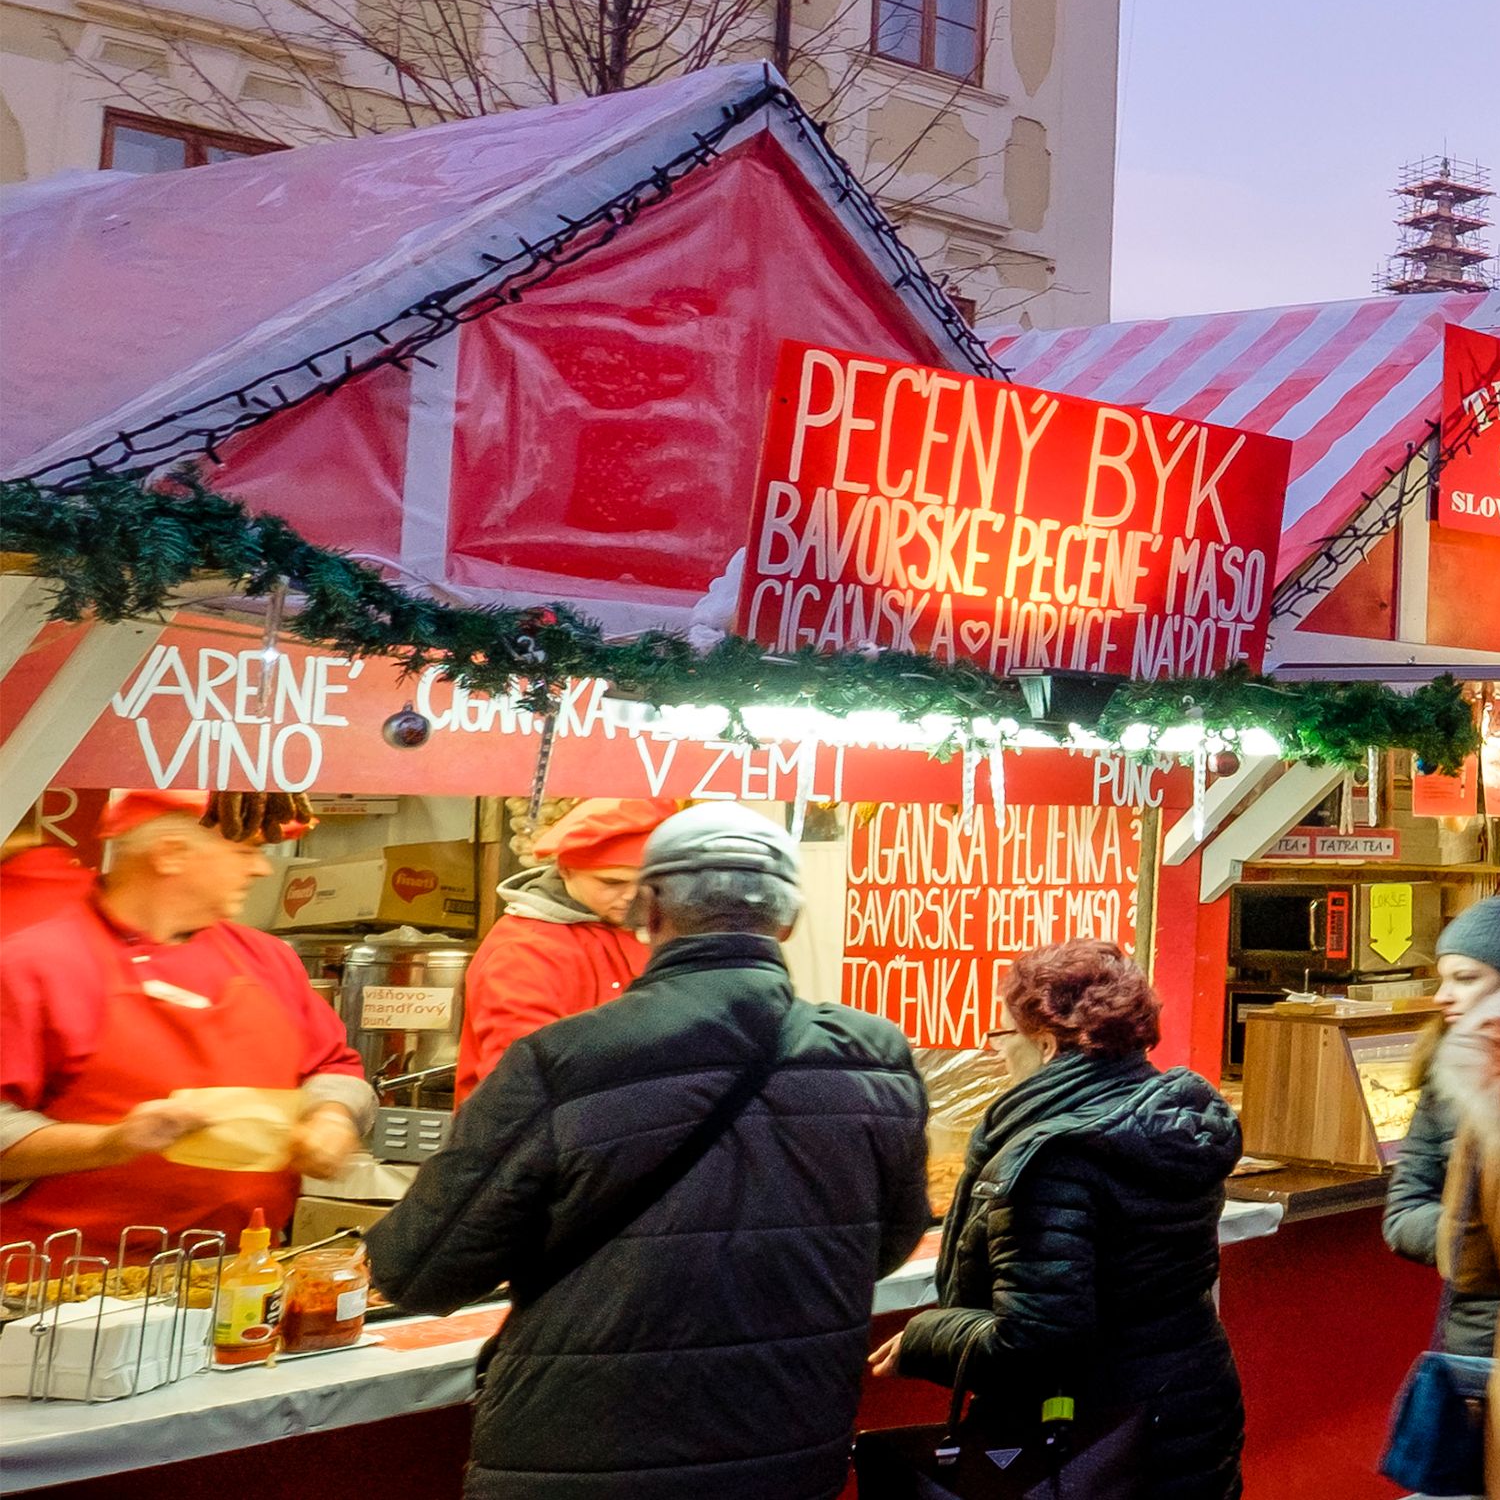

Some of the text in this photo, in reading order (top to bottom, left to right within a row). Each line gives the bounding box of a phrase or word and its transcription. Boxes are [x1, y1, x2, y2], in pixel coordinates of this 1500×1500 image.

[788, 350, 1246, 545] PEČENÝ BÝK
[757, 480, 1005, 596] BAVORSKÉ
[1004, 515, 1163, 613] PEČENÉ
[748, 578, 956, 663] CIGÁNSKA
[135, 716, 323, 793] VÍNO
[635, 737, 678, 797] V
[1093, 754, 1174, 807] PUNČ
[1278, 839, 1300, 850] TEA
[1320, 840, 1383, 851] TATRA TEA
[846, 886, 981, 951] BAVORSKÉ
